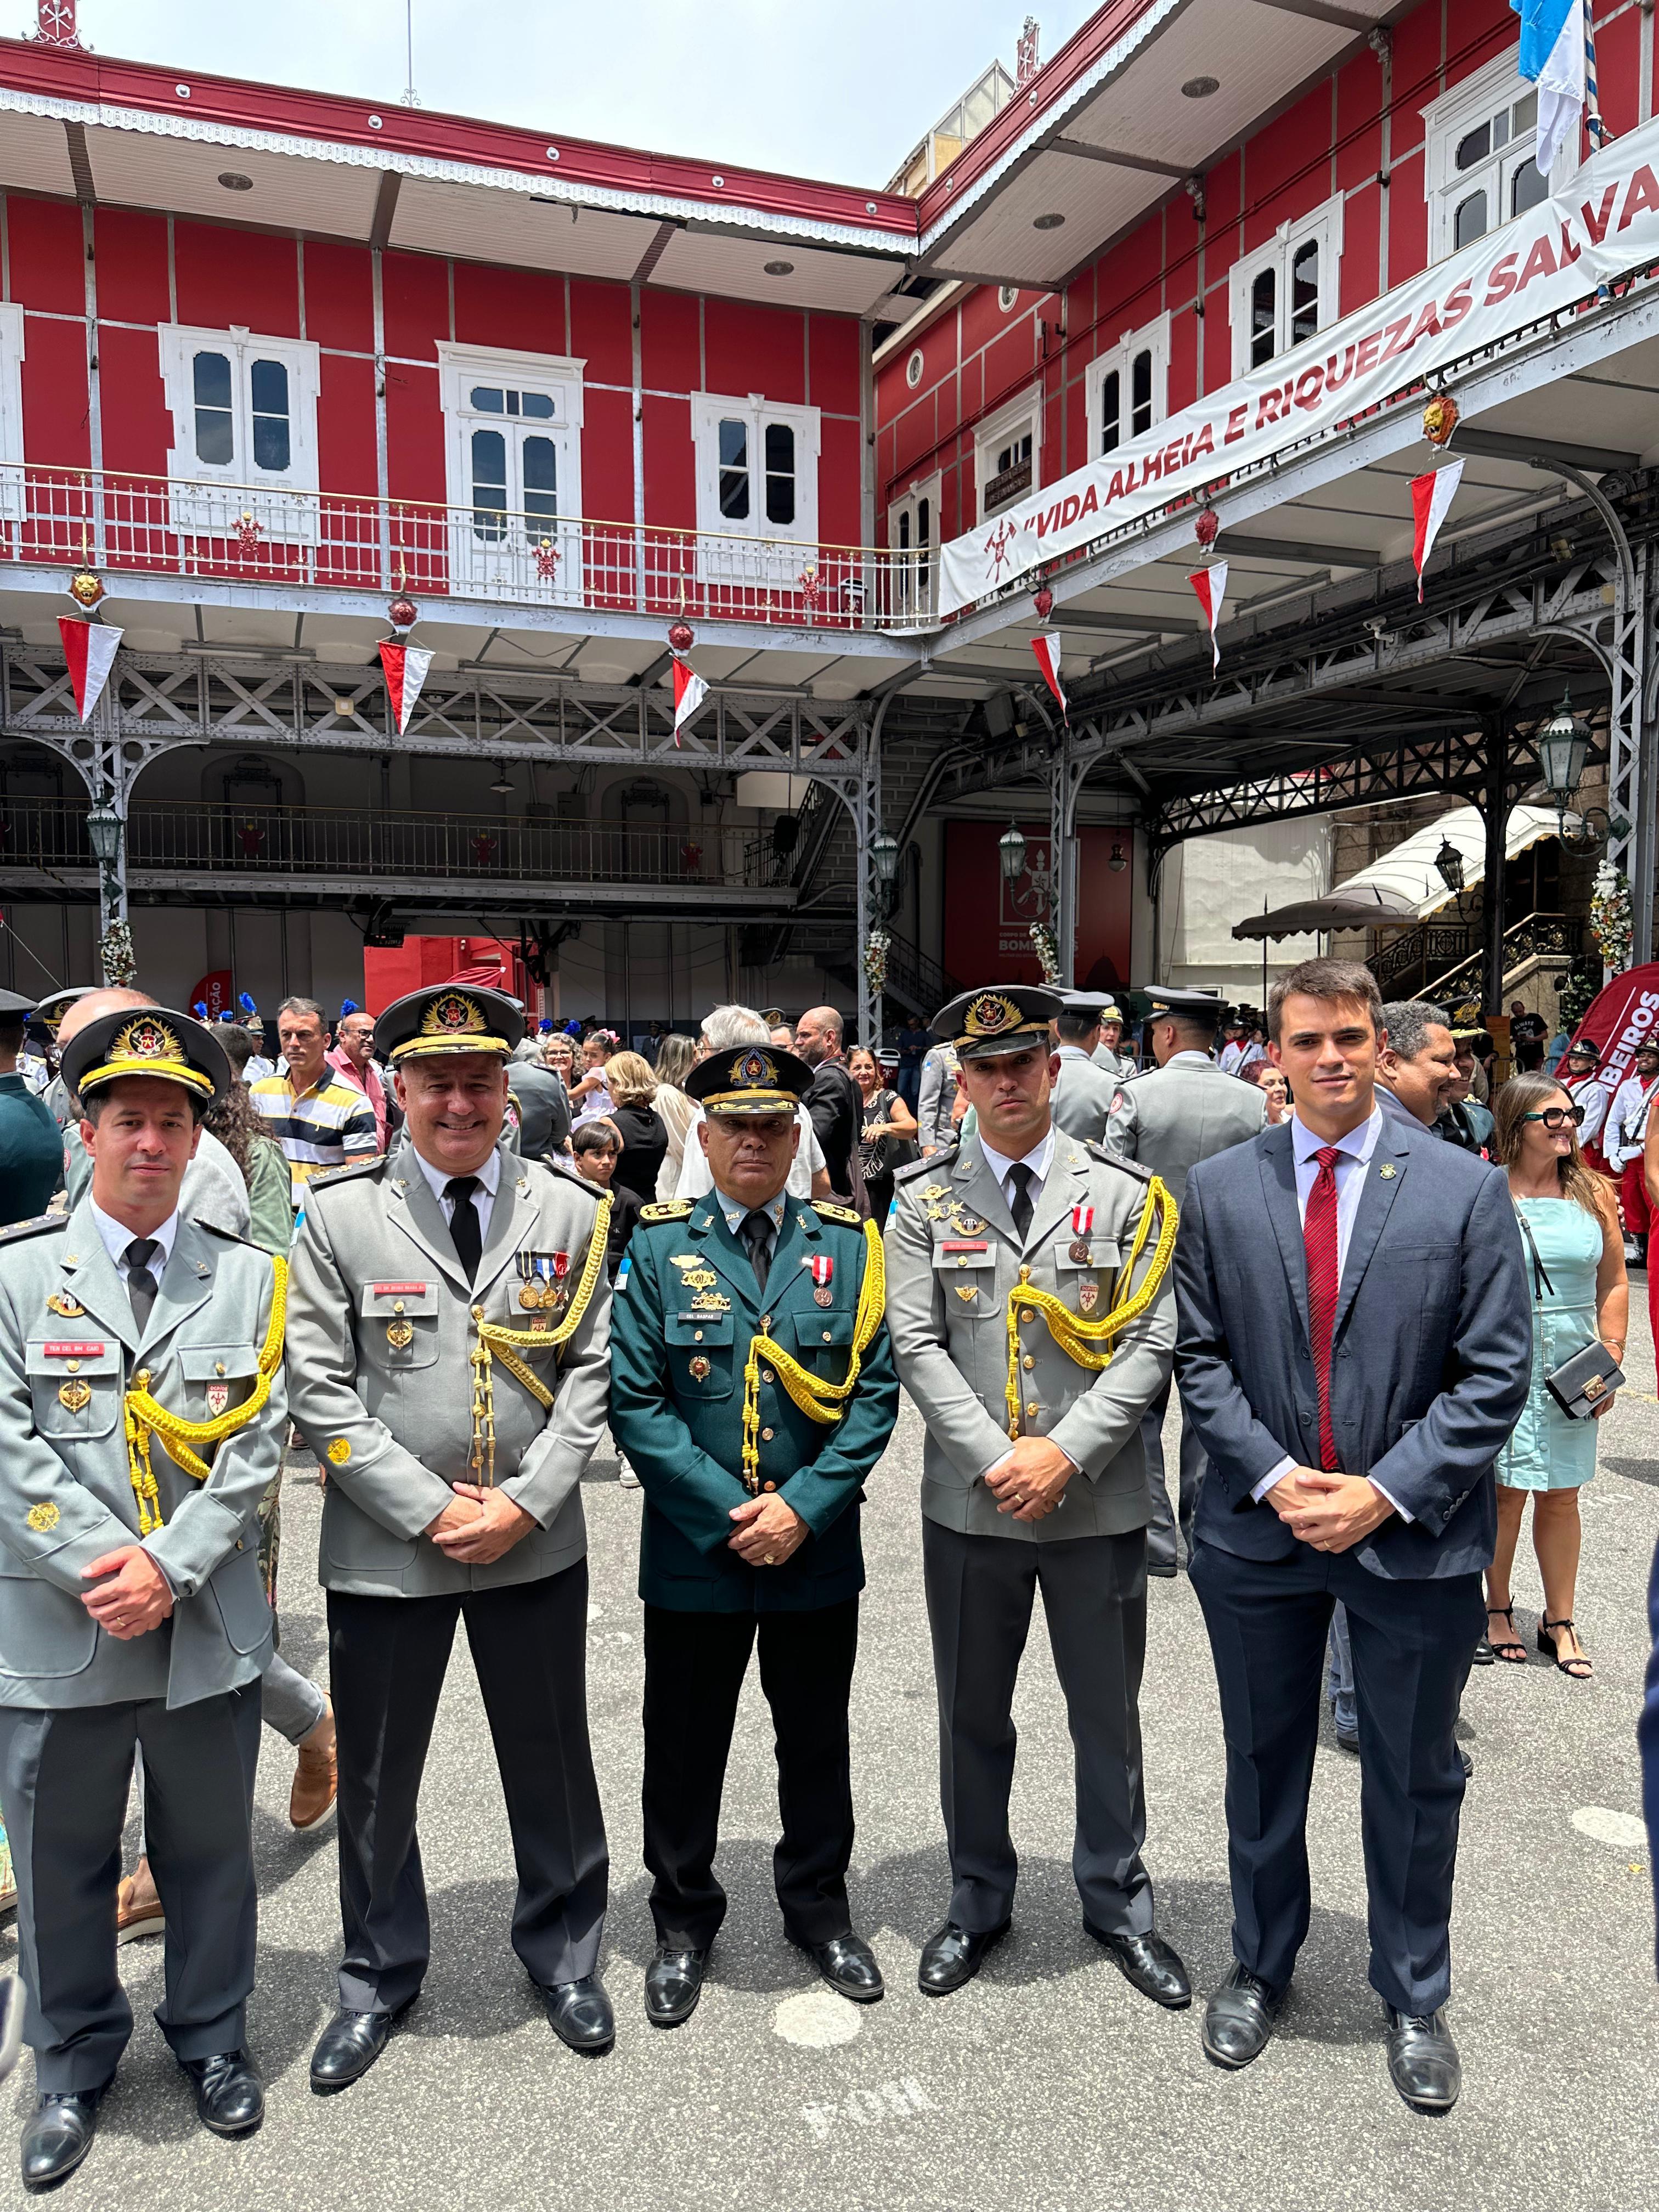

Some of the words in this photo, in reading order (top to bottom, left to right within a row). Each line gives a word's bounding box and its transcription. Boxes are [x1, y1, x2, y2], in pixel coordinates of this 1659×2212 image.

[1104, 423, 1215, 507] ALHEIA
[1224, 403, 1248, 445] E
[1255, 277, 1473, 431] RIQUEZAS
[210, 982, 223, 1019] TAÇÃO
